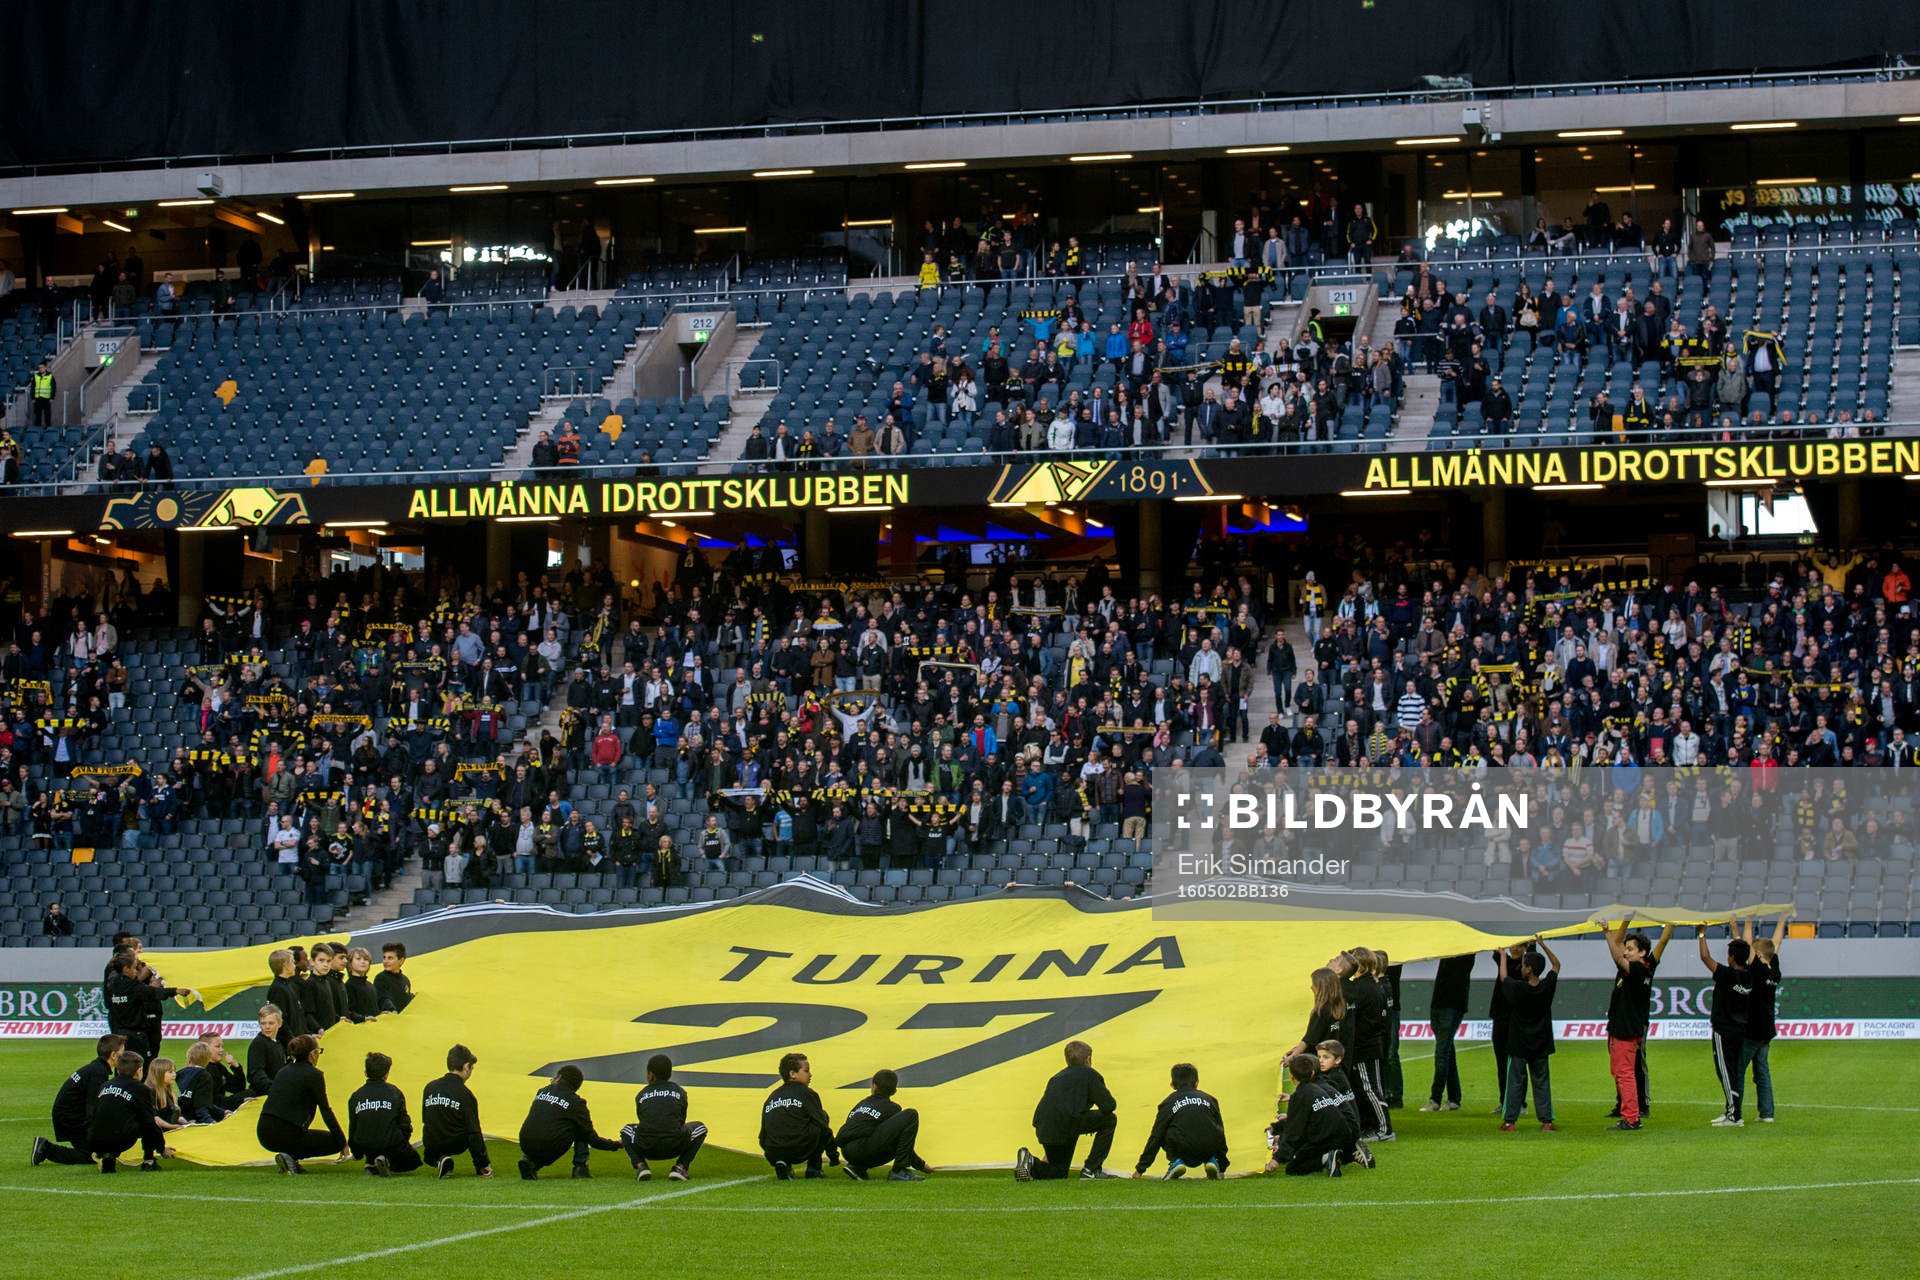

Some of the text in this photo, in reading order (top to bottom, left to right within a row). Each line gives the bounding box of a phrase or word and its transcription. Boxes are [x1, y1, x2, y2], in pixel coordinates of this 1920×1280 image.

[1334, 291, 1352, 301] 211
[692, 318, 712, 328] 212
[99, 342, 117, 352] 213
[1365, 441, 1920, 488] ALLMÄNNA IDROTTSKLUBBEN
[408, 474, 908, 519] ALLMÄNNA IDROTTSKLUBBEN
[720, 935, 1186, 984] TURINA
[528, 989, 1162, 1089] 27
[1774, 1023, 1855, 1037] ROMM
[1172, 1096, 1211, 1114] aikshop.se
